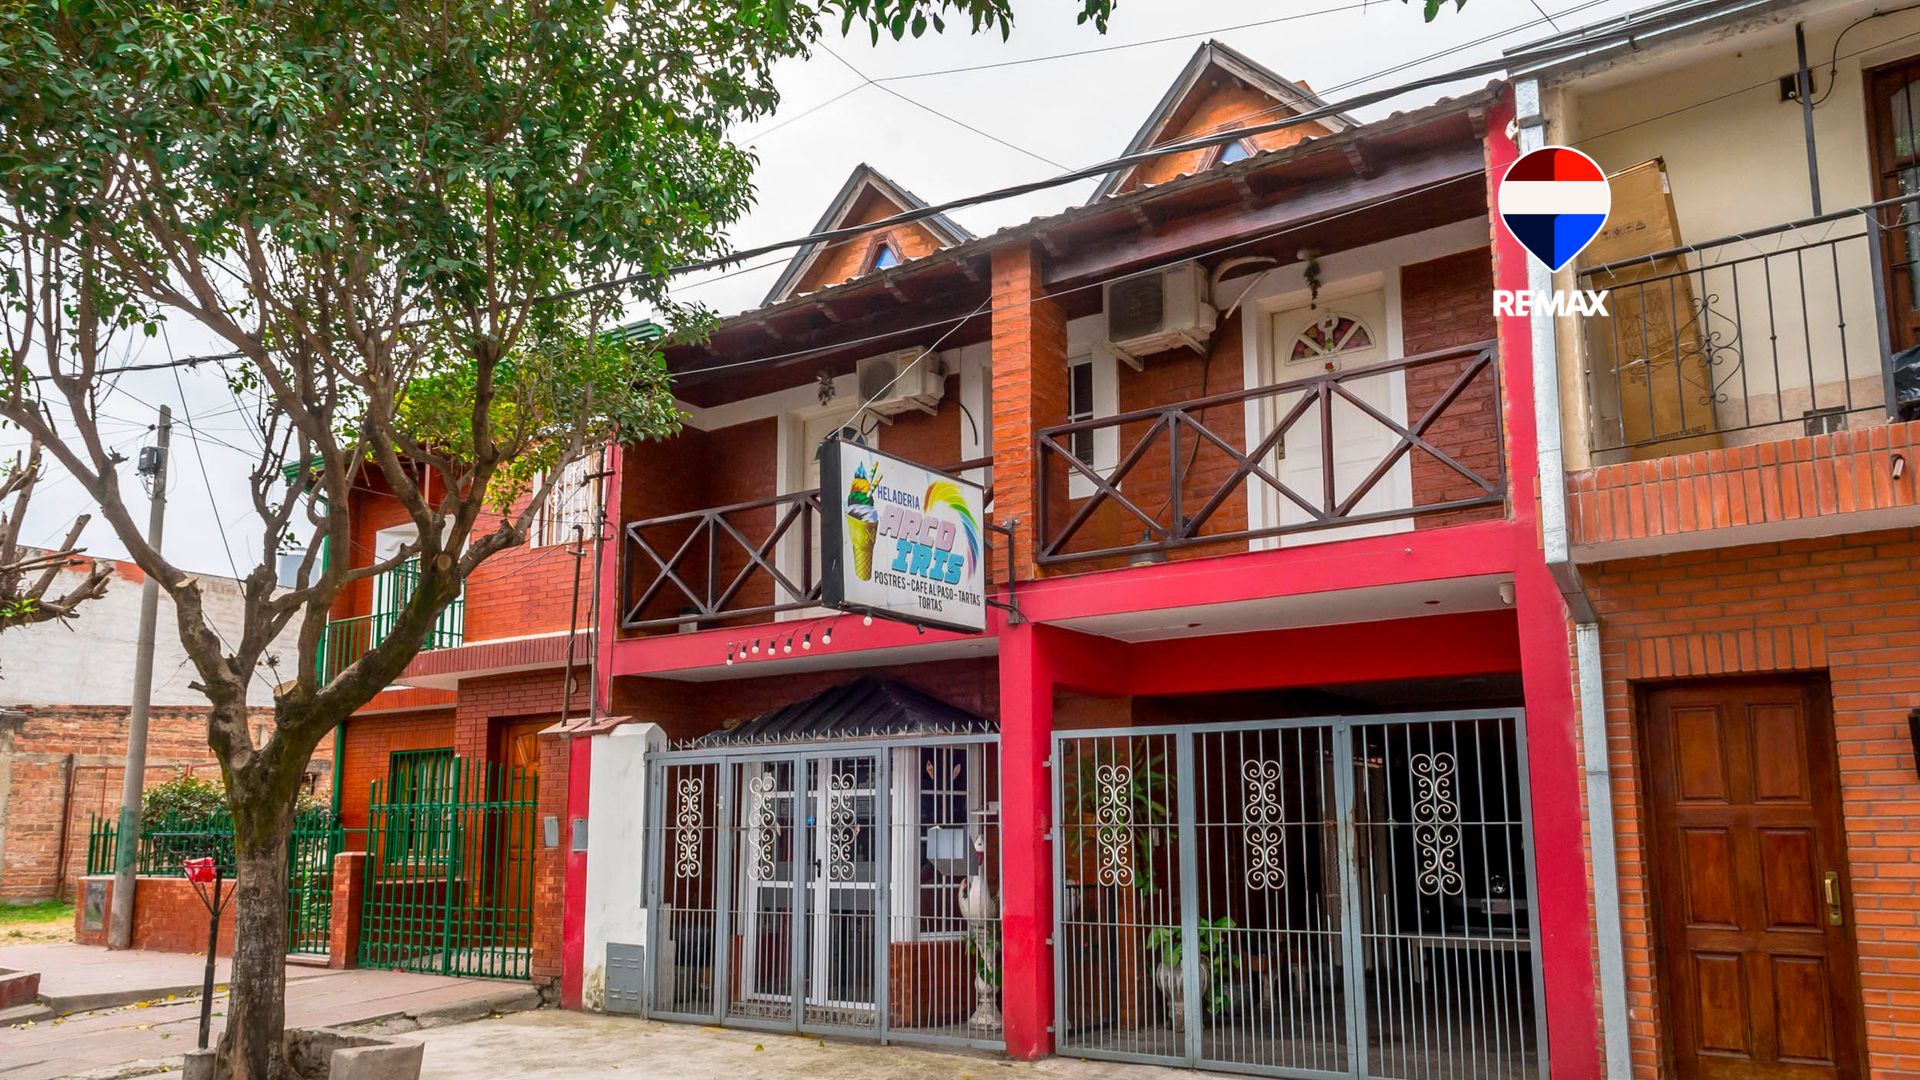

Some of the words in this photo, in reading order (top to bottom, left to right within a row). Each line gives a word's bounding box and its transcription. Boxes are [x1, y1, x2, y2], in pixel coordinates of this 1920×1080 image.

[877, 485, 920, 510] HELADERIA
[879, 505, 957, 551] ARCO
[891, 538, 965, 585] IRIS
[874, 571, 906, 591] POSTRES
[911, 579, 928, 595] CAFE
[958, 590, 981, 606] TARTAS
[918, 595, 943, 612] TORTAS
